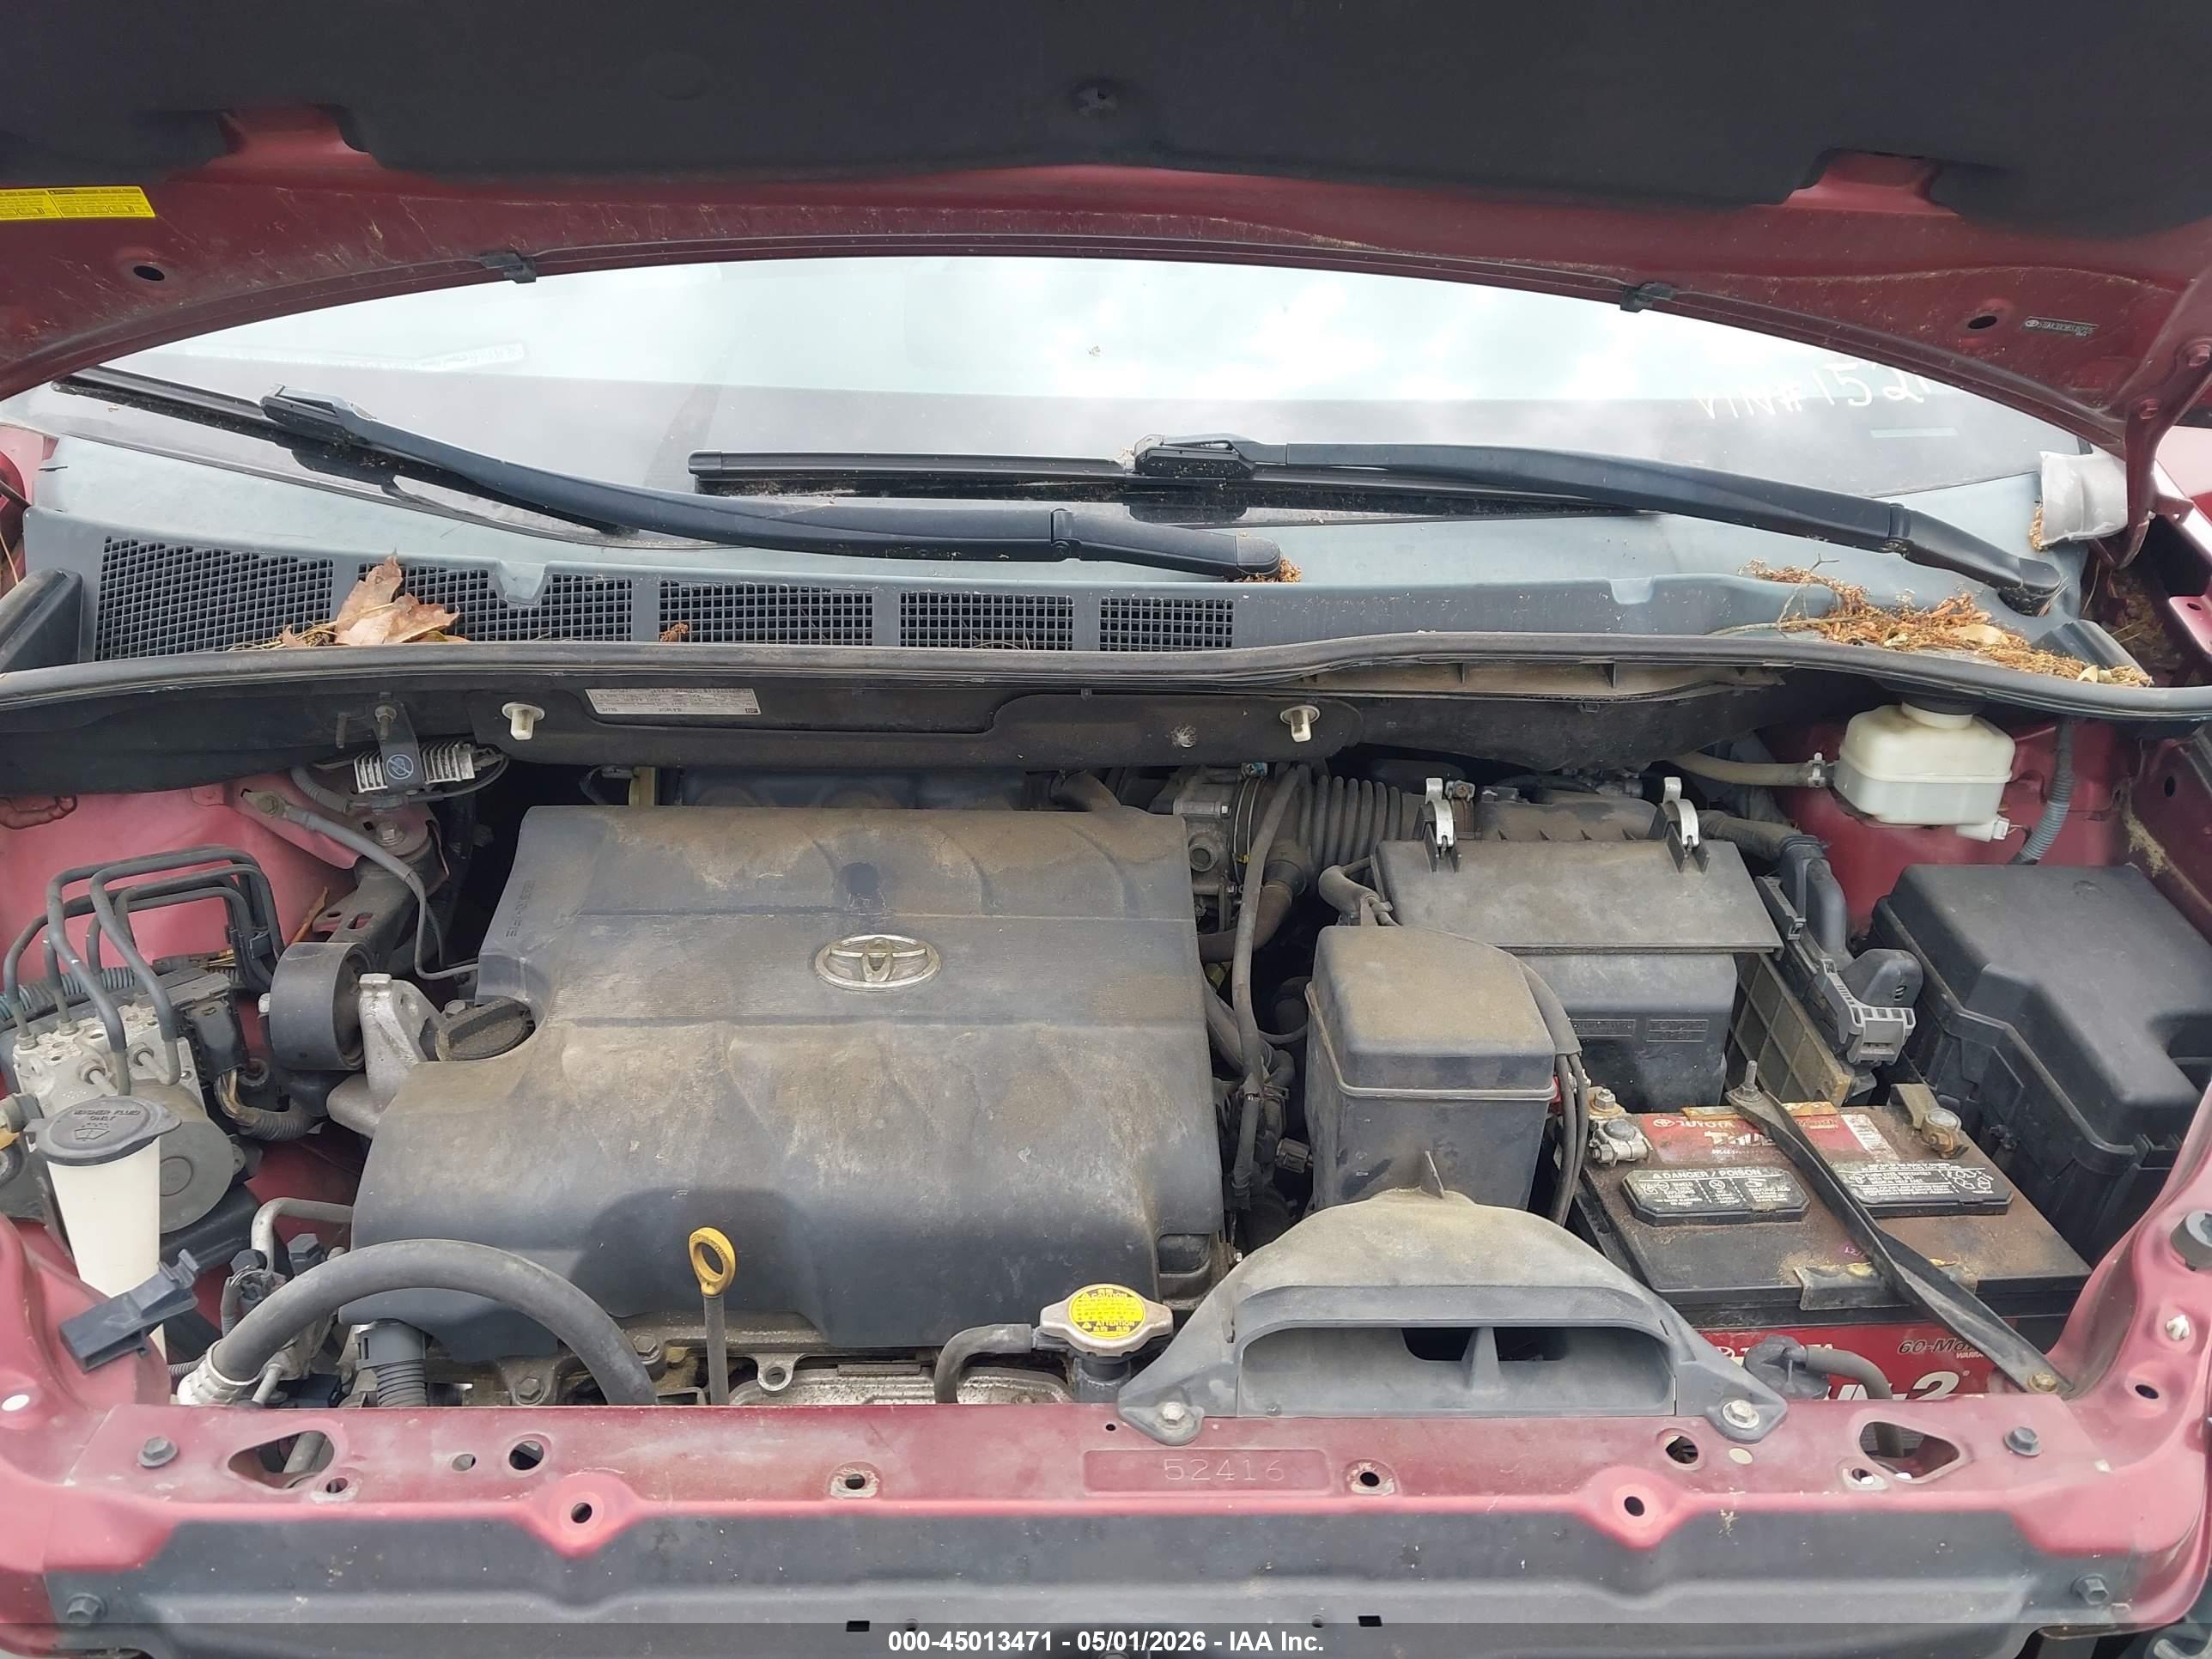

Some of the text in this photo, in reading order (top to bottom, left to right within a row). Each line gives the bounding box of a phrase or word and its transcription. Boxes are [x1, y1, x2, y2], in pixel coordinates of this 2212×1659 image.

[1662, 1168, 1762, 1179] DANGER / POISON
[1164, 1458, 1285, 1481] 52416
